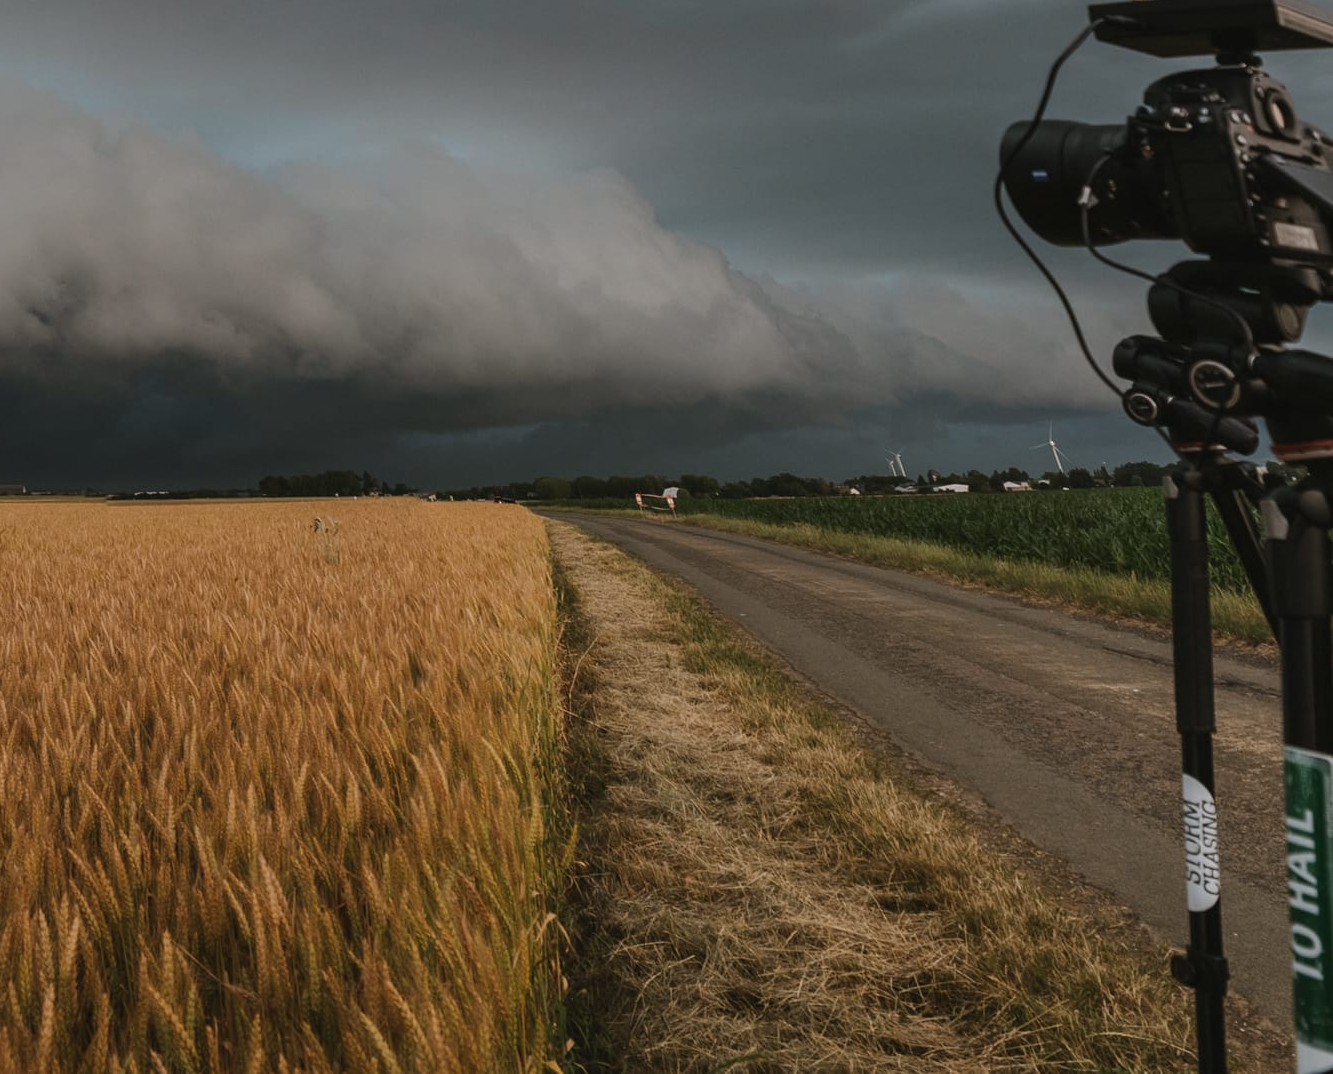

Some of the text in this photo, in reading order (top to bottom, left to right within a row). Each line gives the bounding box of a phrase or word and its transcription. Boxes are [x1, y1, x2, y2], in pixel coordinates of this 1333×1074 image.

[1183, 799, 1201, 886] STORM
[1201, 800, 1220, 896] CHASING
[1286, 809, 1320, 916] HAIL
